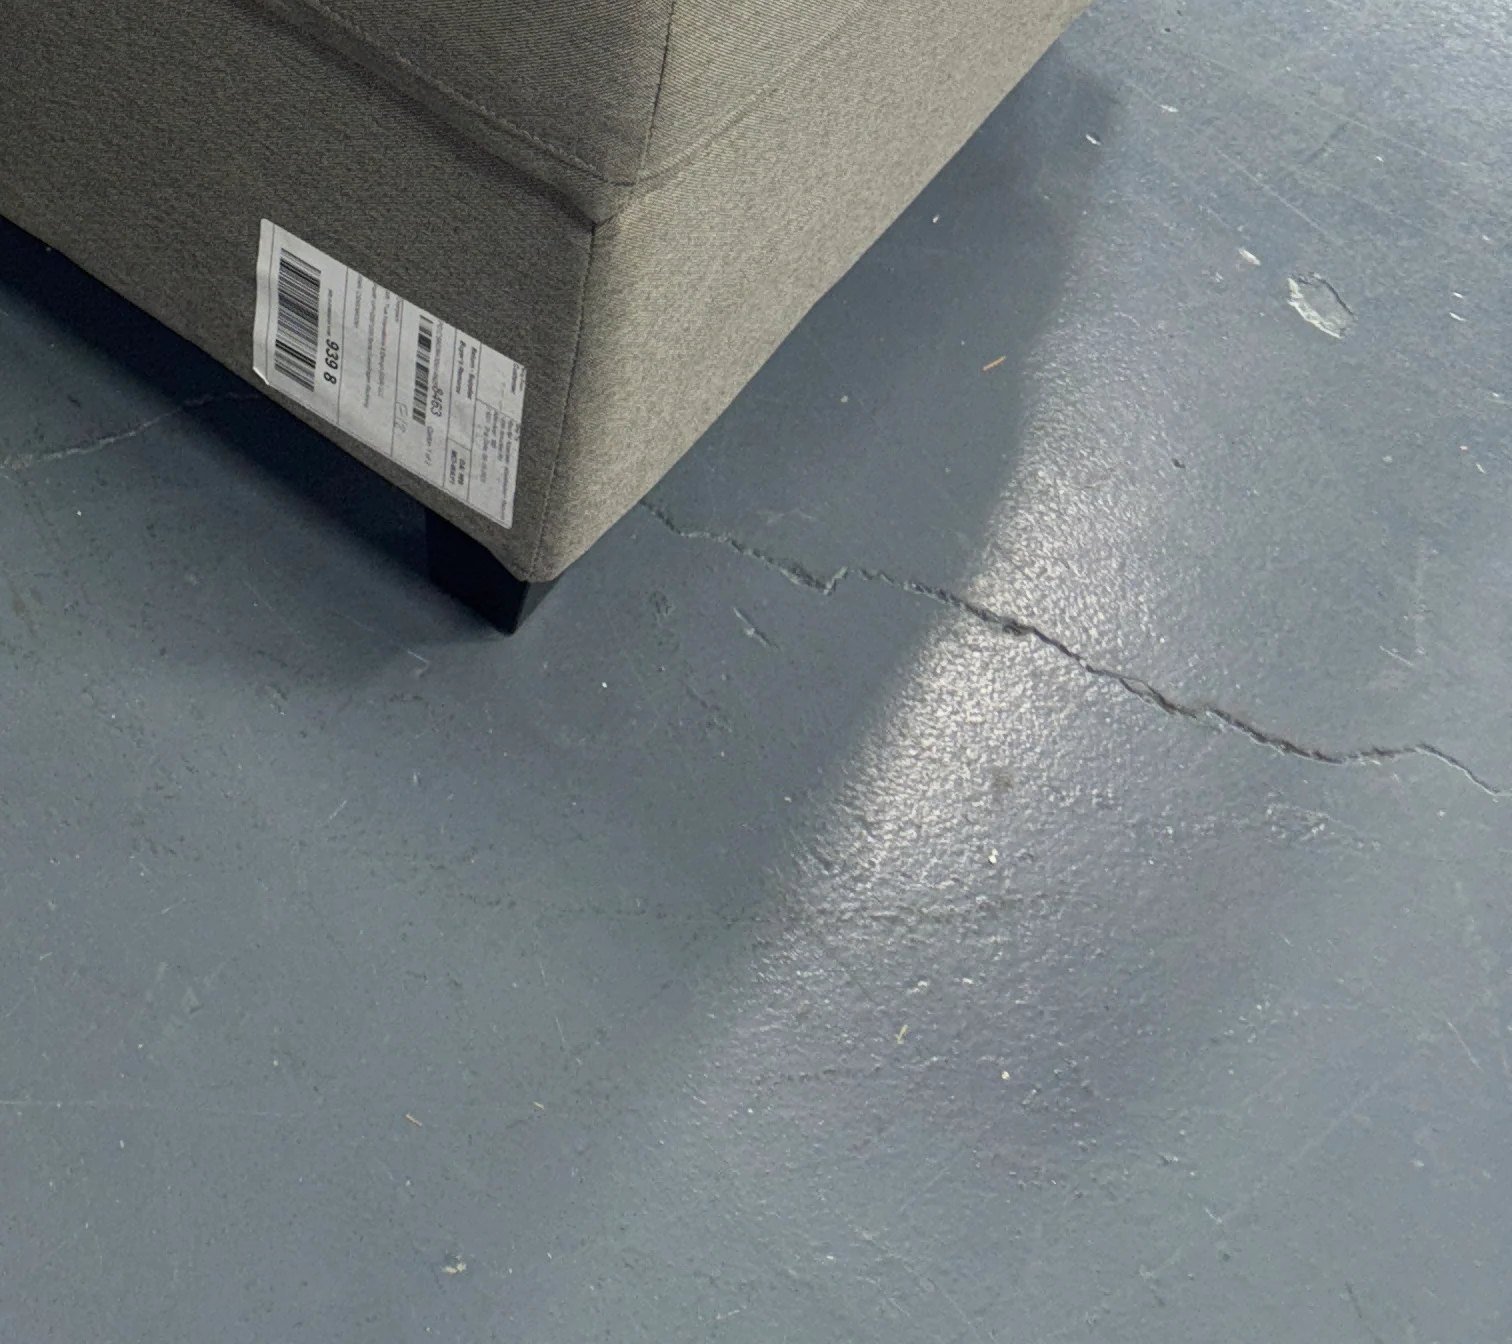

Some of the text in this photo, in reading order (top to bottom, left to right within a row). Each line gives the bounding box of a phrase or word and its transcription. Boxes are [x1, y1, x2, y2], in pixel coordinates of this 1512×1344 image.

[324, 337, 339, 371] 939
[323, 369, 337, 386] 8
[430, 384, 443, 418] 8463
